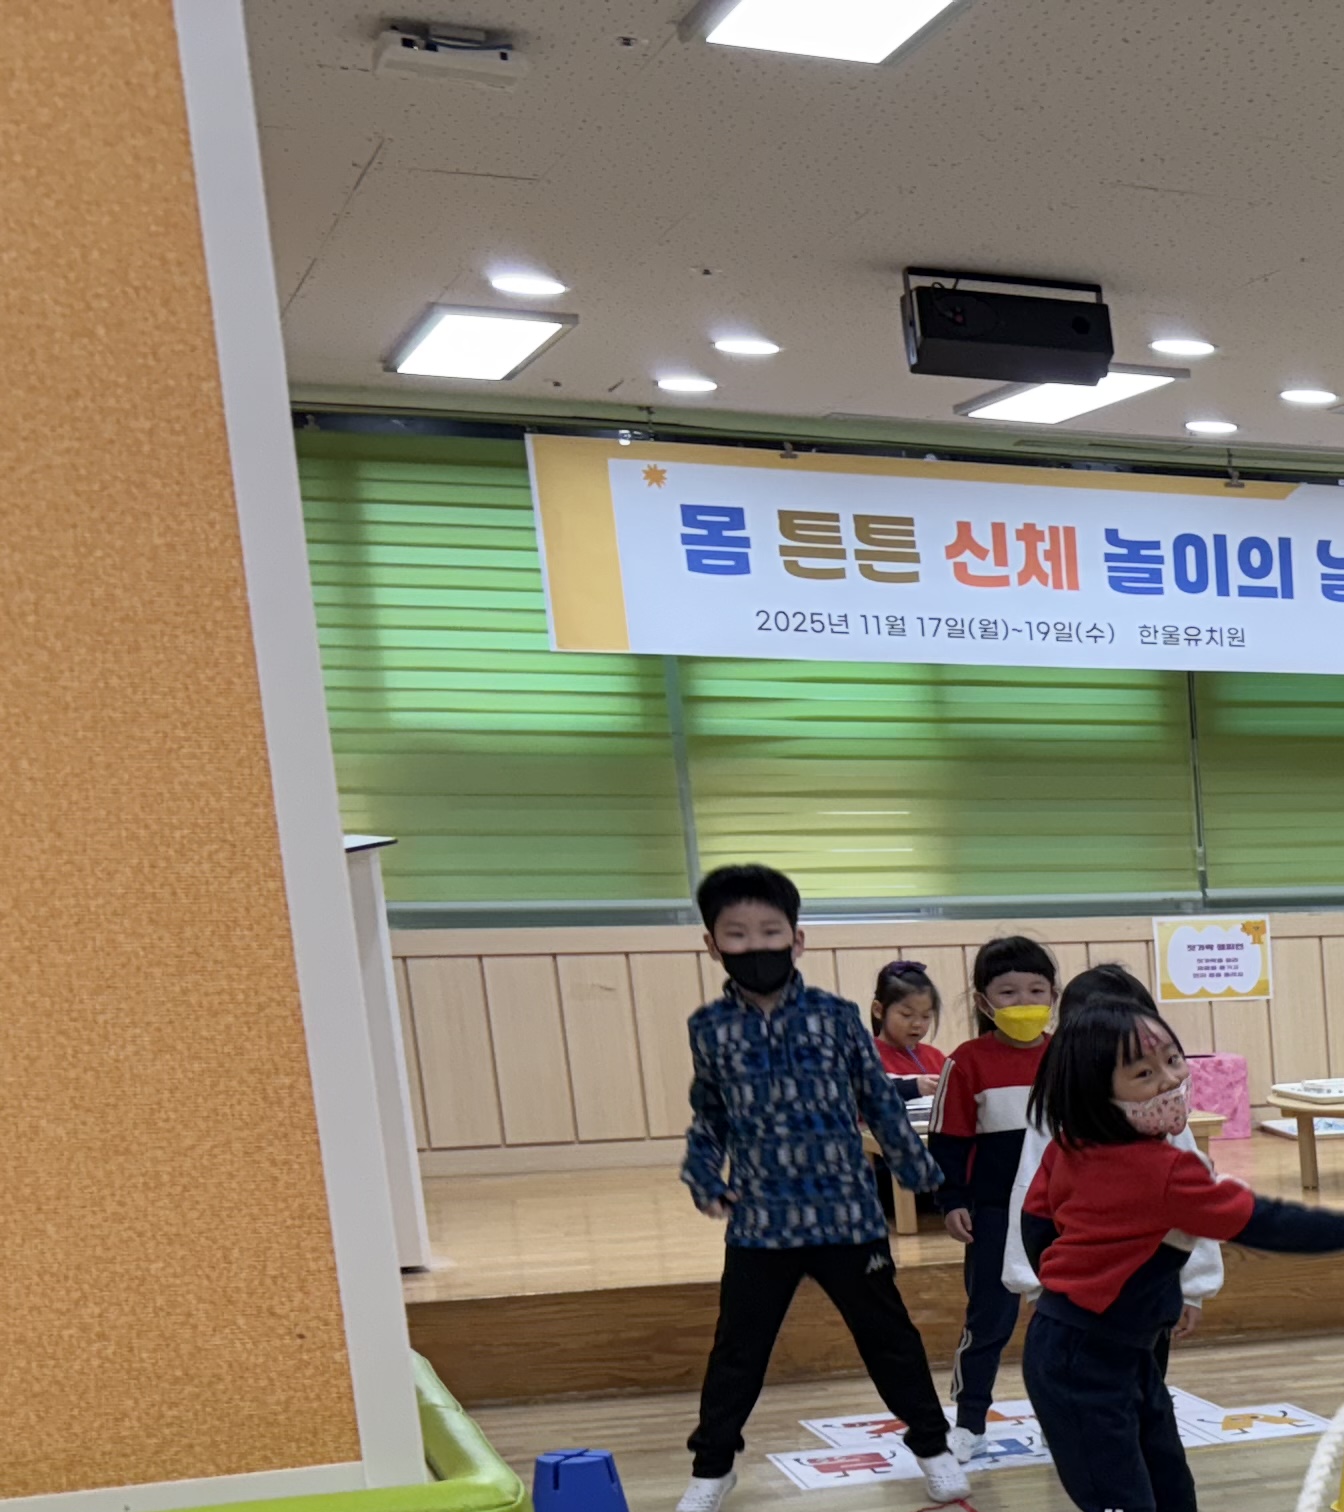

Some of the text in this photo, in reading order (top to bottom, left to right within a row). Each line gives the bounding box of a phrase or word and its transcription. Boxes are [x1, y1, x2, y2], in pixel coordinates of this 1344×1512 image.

[680, 503, 751, 576] 몸
[777, 508, 921, 584] 튼튼
[944, 520, 1080, 591] 신체
[1104, 527, 1294, 600] 놀이의
[755, 609, 1247, 648] 2025년 11월 17일(월)~19일(수) 한울유치원
